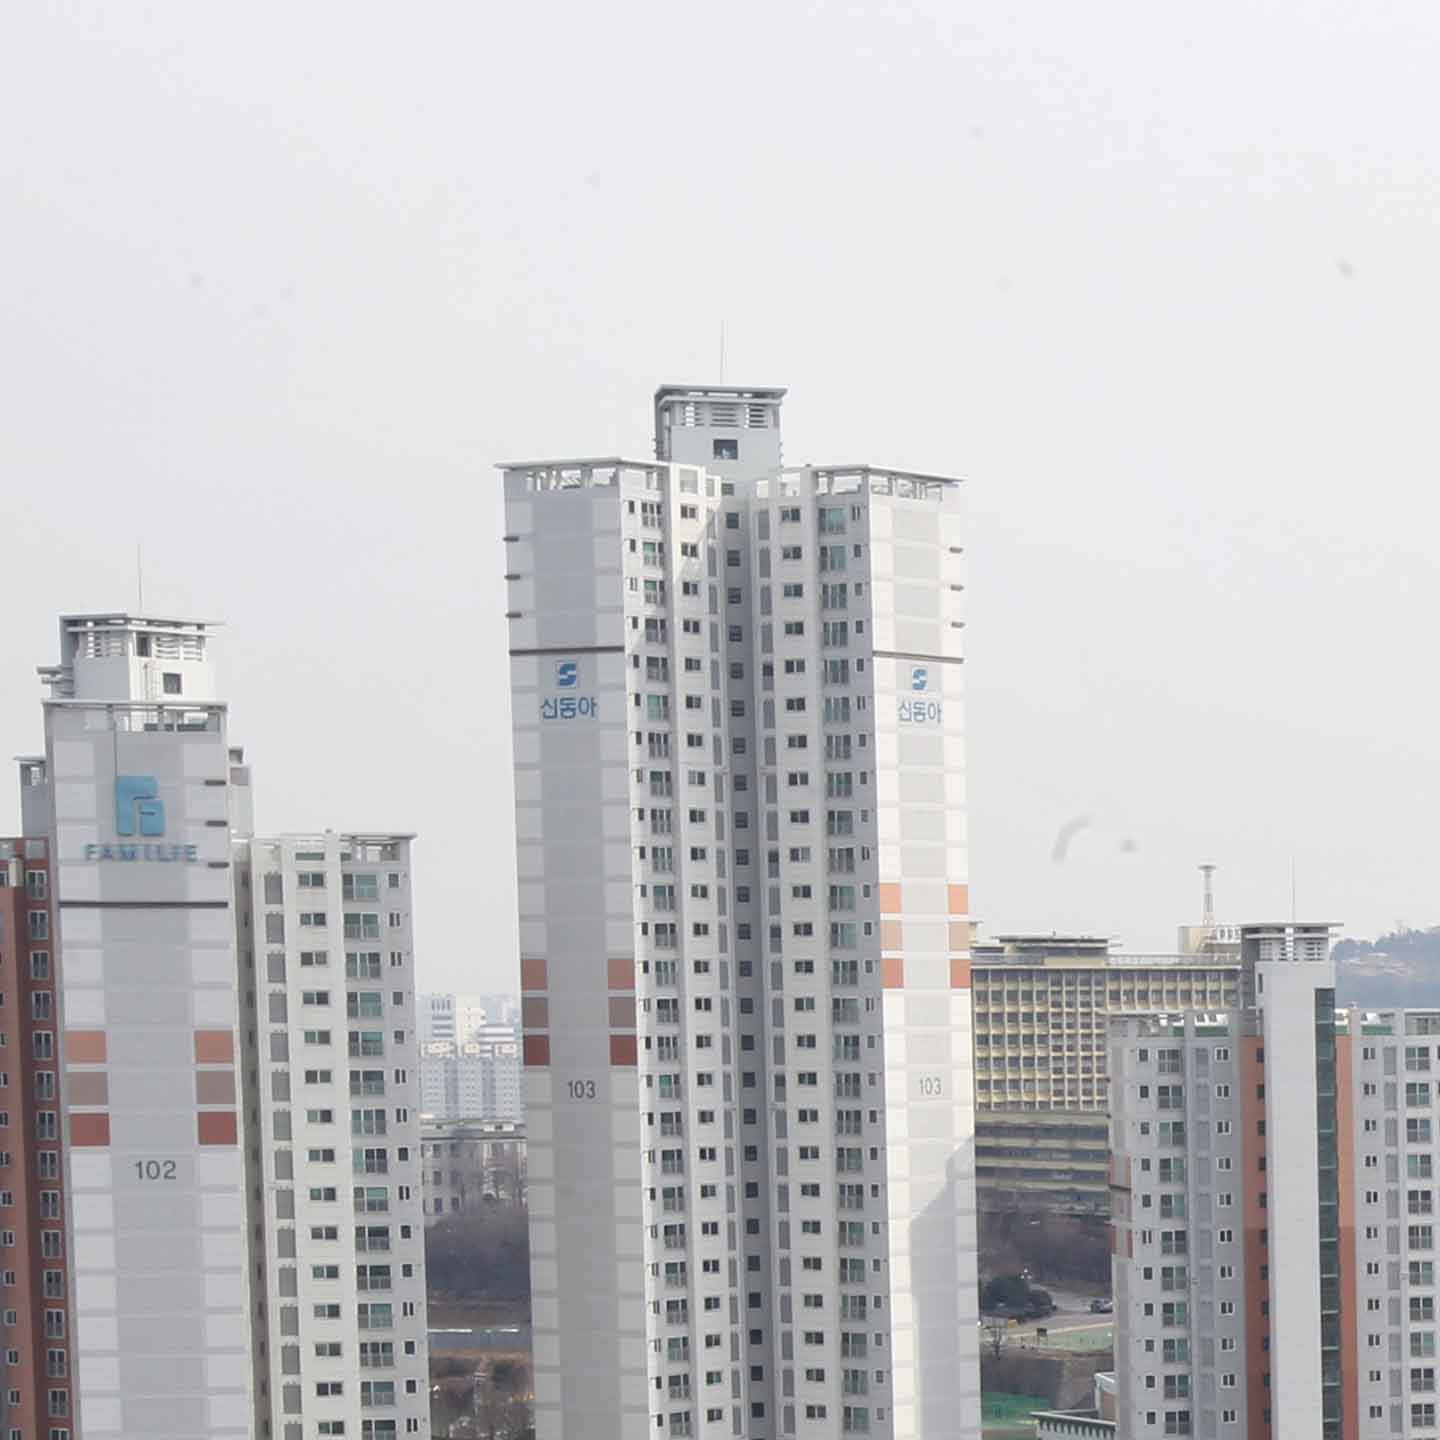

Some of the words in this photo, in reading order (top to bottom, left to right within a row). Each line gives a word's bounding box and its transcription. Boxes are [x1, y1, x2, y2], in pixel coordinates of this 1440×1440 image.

[541, 697, 597, 719] 신동아
[898, 701, 942, 724] 신동아
[86, 844, 197, 861] FAMILIE
[568, 1080, 596, 1098] 103
[920, 1078, 941, 1095] 103
[135, 1160, 177, 1180] 102
